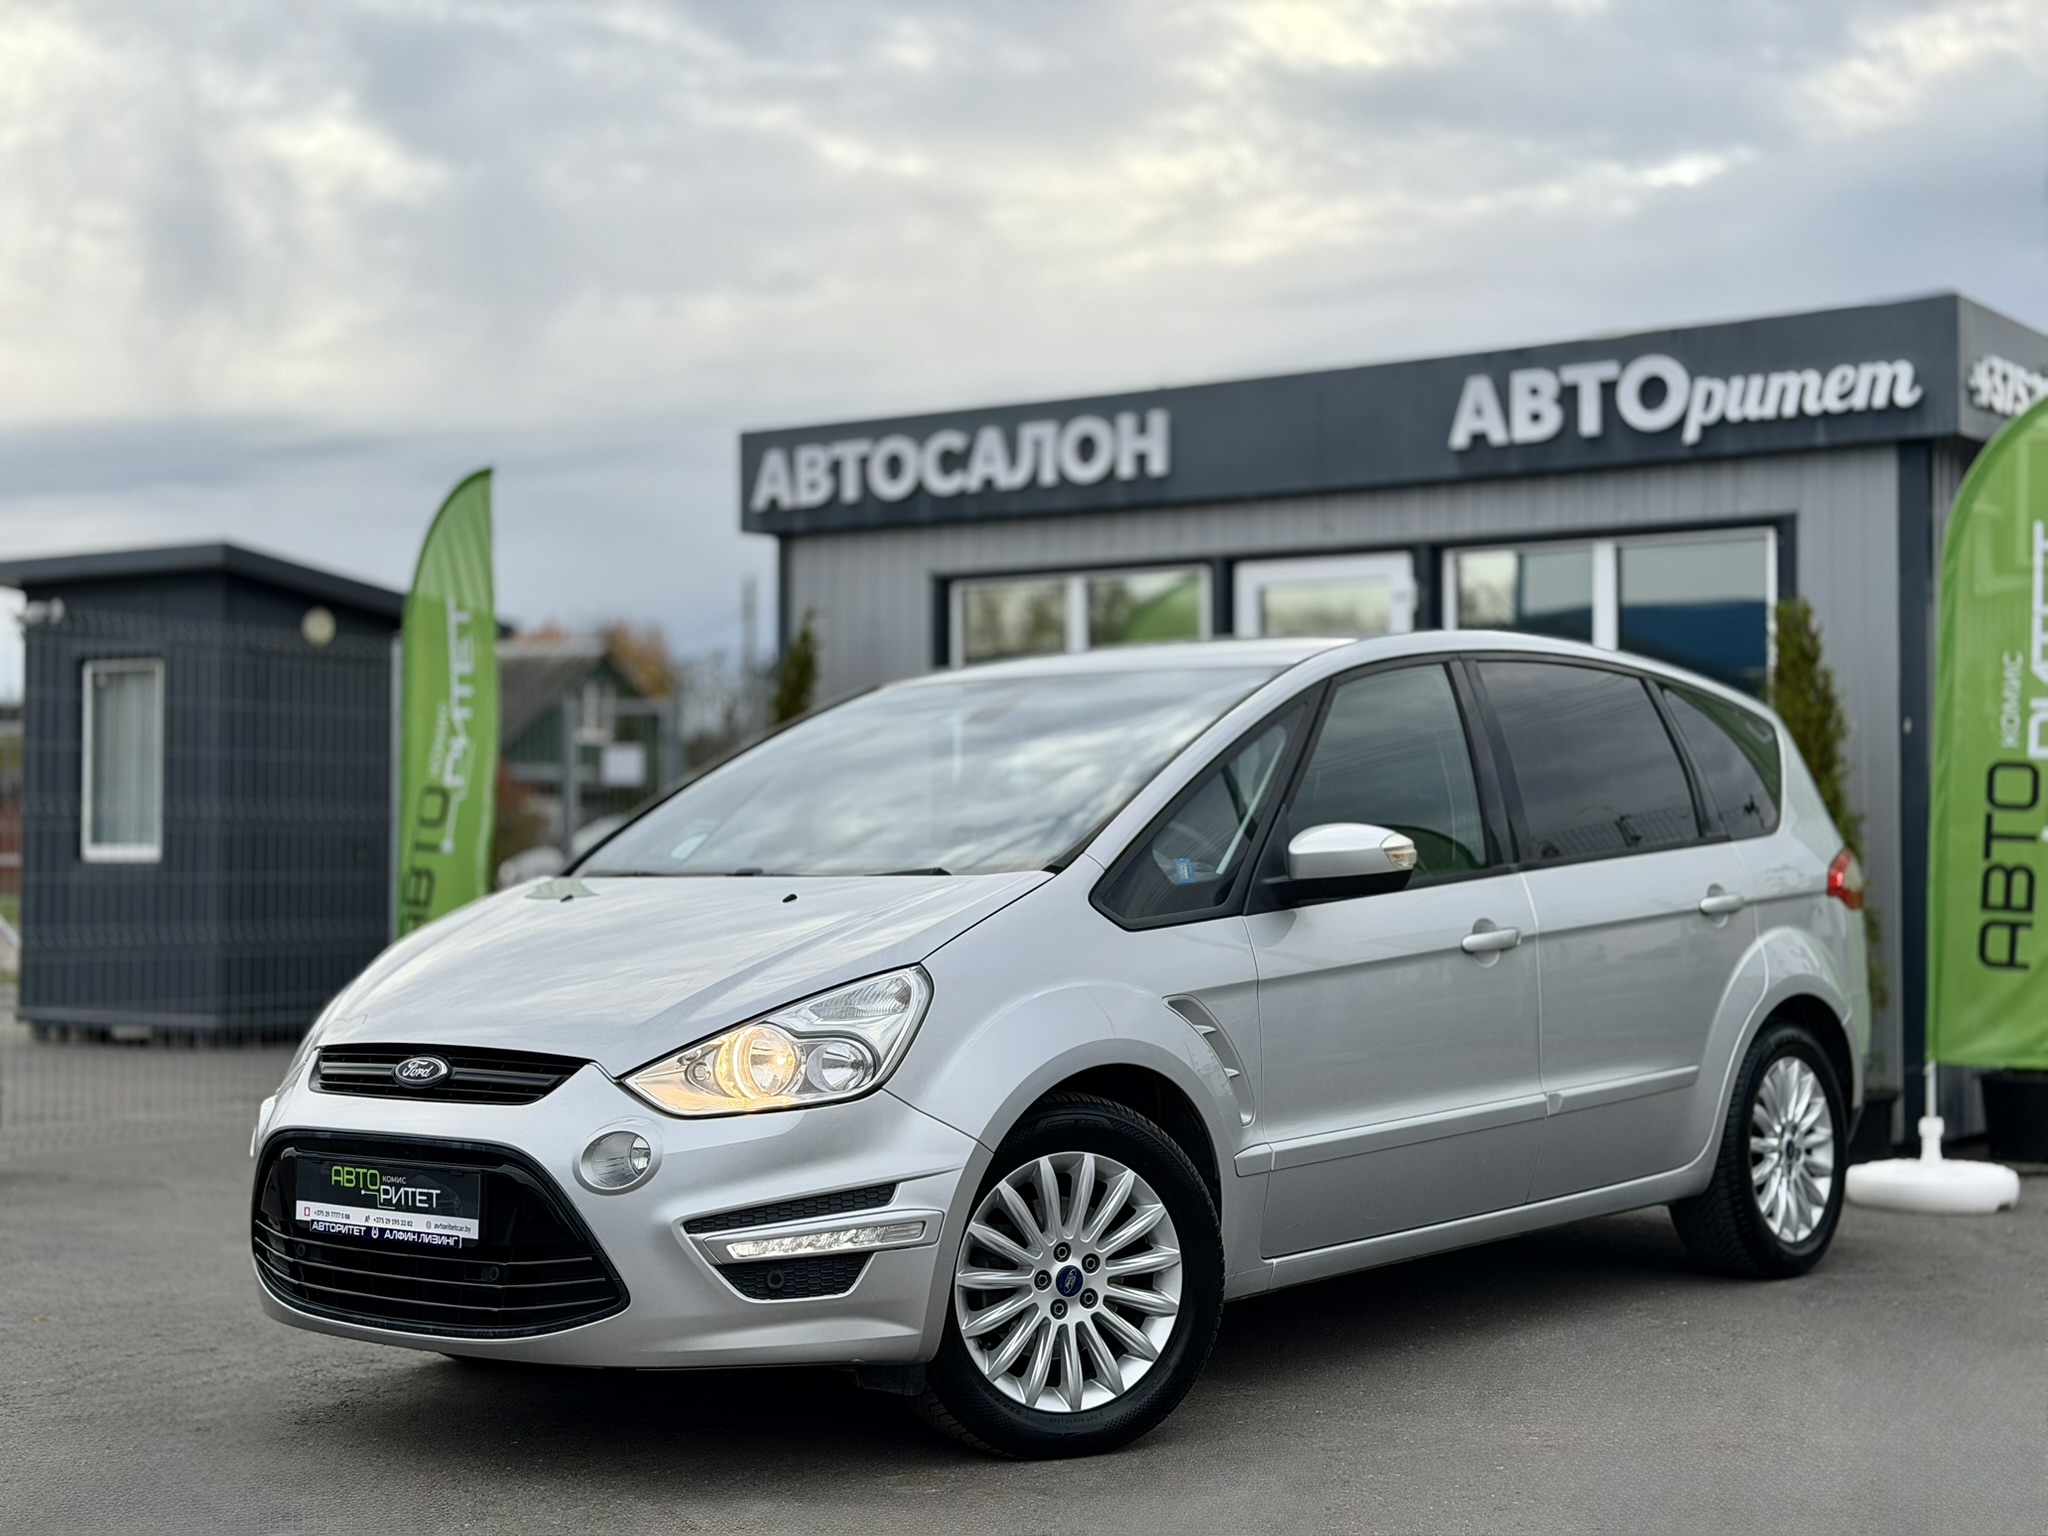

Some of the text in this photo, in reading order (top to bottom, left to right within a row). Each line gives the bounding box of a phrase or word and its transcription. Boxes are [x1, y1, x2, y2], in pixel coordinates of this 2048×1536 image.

[1447, 353, 1924, 450] АВТОритет
[749, 408, 1171, 513] АВТОСАЛОН
[1977, 760, 2040, 971] АВТО
[402, 1060, 434, 1077] Ford
[331, 1166, 380, 1190] АВТО
[382, 1175, 407, 1185] КОМИС
[380, 1185, 441, 1208] РИТЕТ
[311, 1221, 459, 1247] АВТОРИТЕТ АЛФИН ЛИЗИНГ
